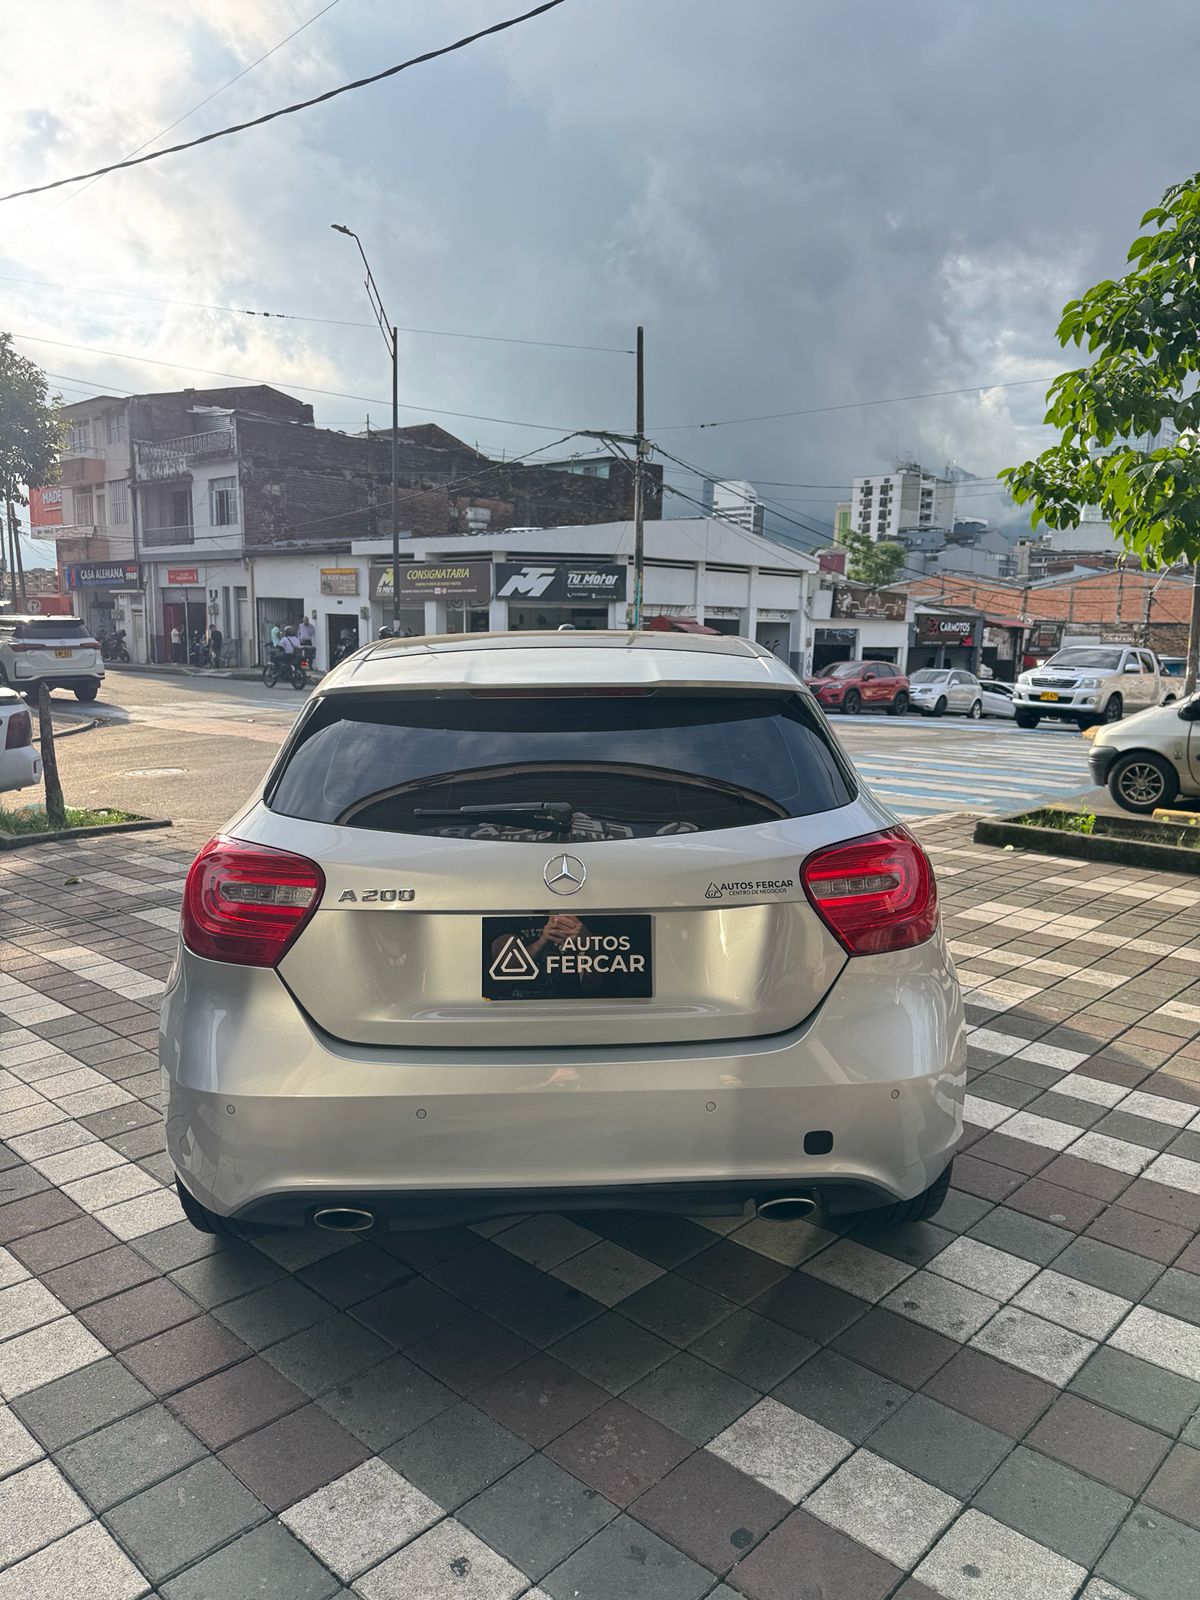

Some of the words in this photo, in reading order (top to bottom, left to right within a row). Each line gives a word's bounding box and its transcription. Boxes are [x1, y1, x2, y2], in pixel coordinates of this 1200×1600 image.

[80, 569, 95, 579] CASA
[95, 567, 124, 579] ALEMANA
[406, 568, 470, 580] CONSIGNATARIA
[582, 573, 619, 585] Motor
[940, 621, 970, 632] CARMOTOS
[721, 882, 753, 890] AUTOS
[756, 880, 793, 888] FERCAR
[338, 888, 358, 902] A
[361, 888, 416, 902] 200
[561, 935, 631, 951] AUTOS
[546, 954, 645, 974] FERCAR
